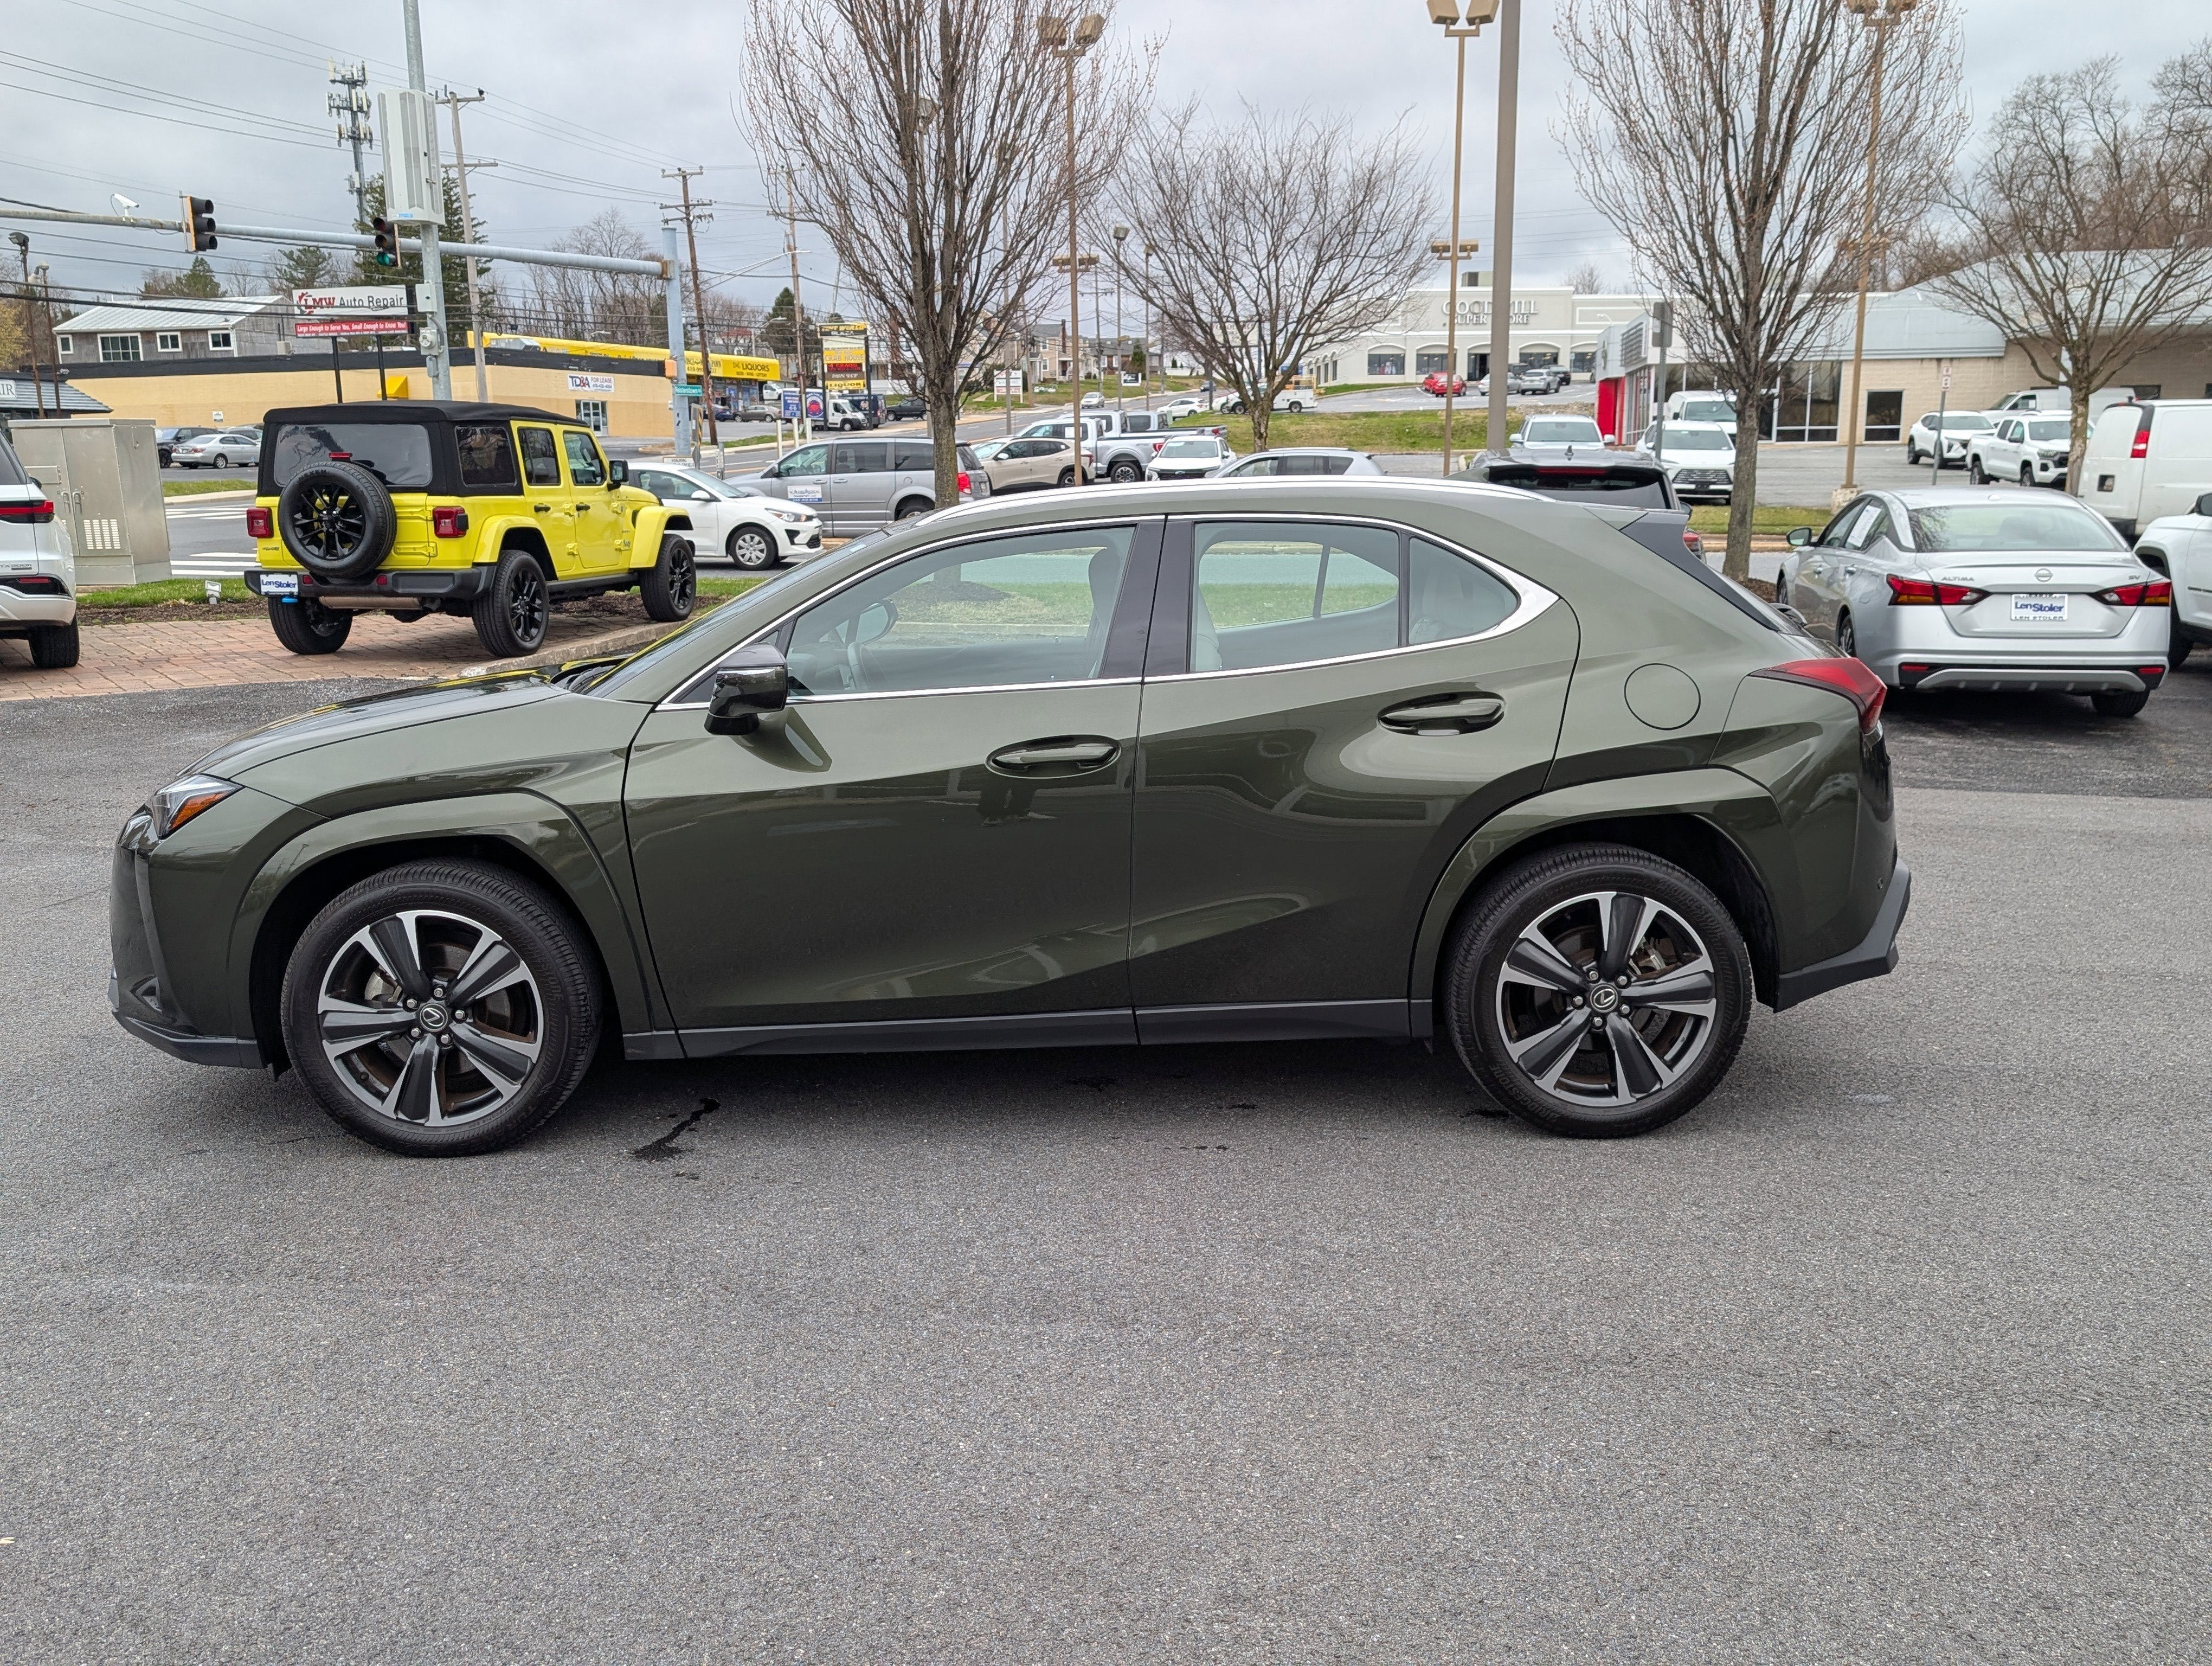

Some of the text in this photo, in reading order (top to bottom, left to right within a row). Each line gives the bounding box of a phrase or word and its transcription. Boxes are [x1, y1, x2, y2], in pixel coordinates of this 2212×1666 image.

[339, 297, 364, 307] Auto
[368, 294, 403, 309] Repair
[297, 325, 308, 333] Large
[363, 322, 378, 330] Enough
[742, 362, 769, 371] LIQUORS
[0, 383, 15, 395] IR
